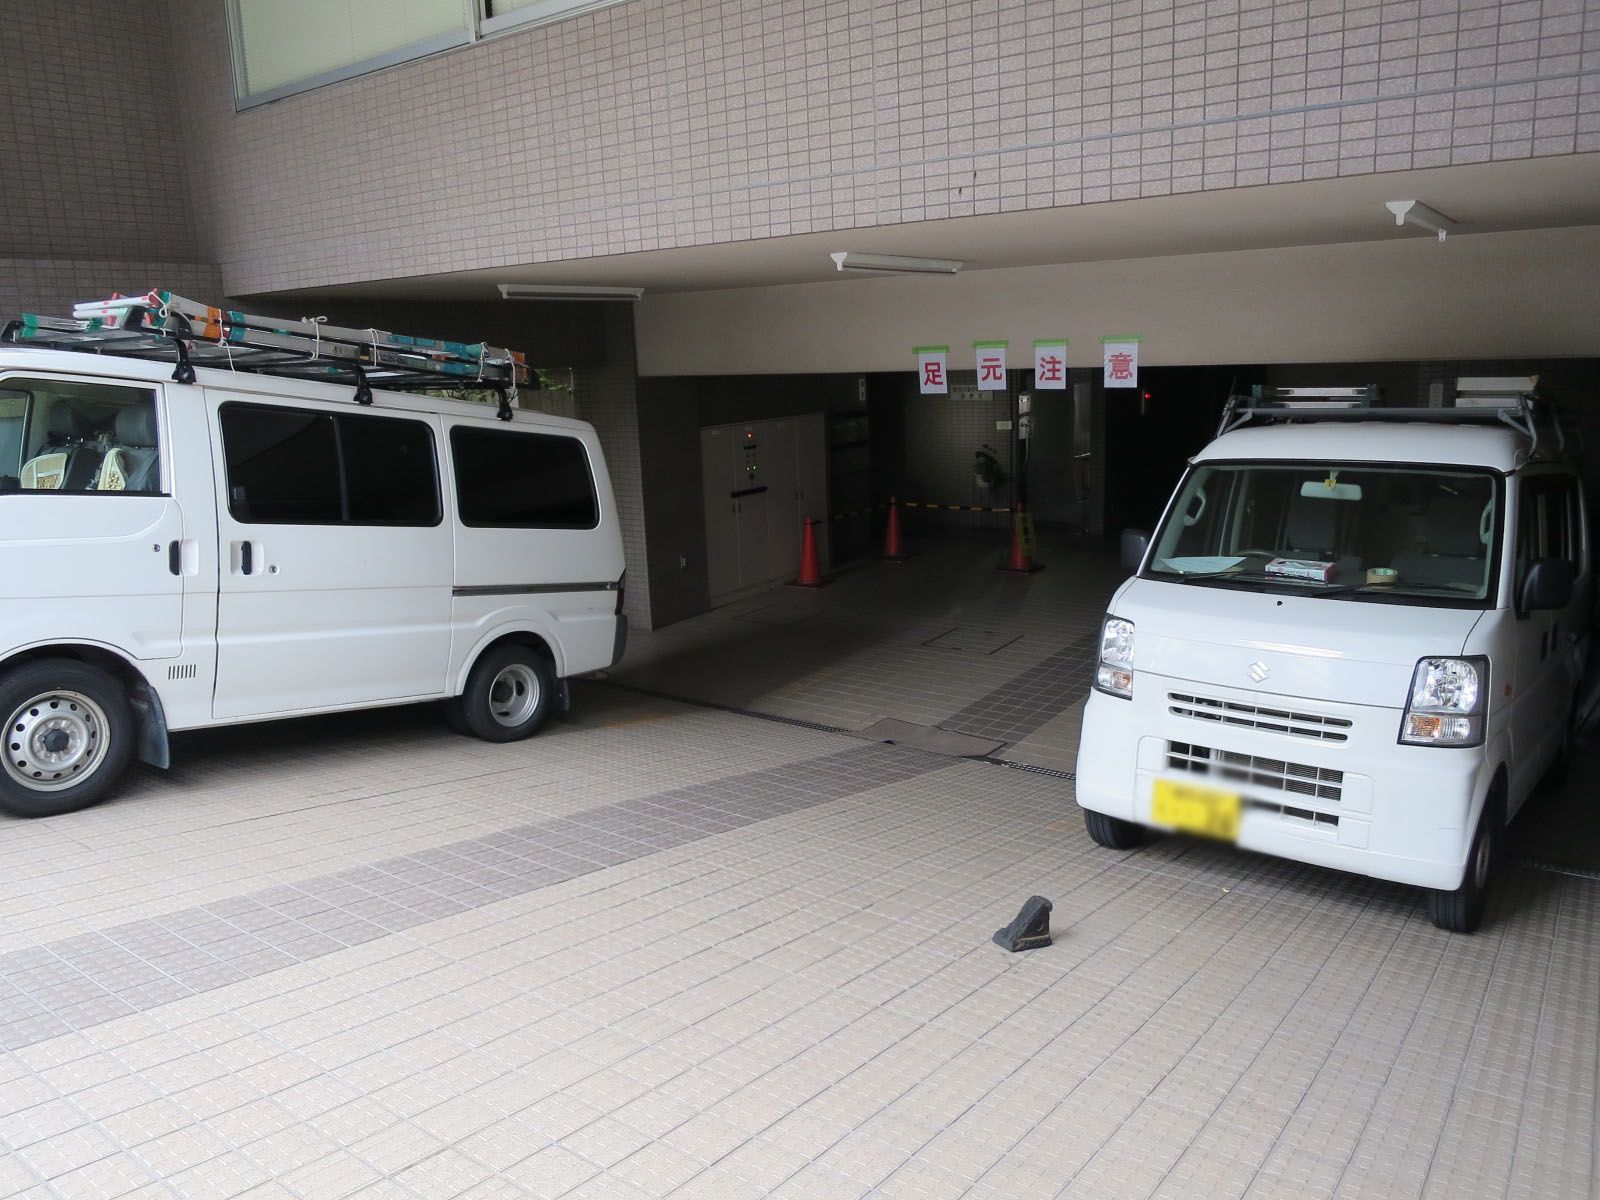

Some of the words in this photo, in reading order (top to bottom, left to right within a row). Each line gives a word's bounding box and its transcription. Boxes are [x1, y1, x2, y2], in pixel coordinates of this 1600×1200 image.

[924, 362, 943, 385] 足
[981, 358, 1002, 381] 元
[1039, 356, 1062, 381] 注
[1109, 353, 1133, 380] 意
